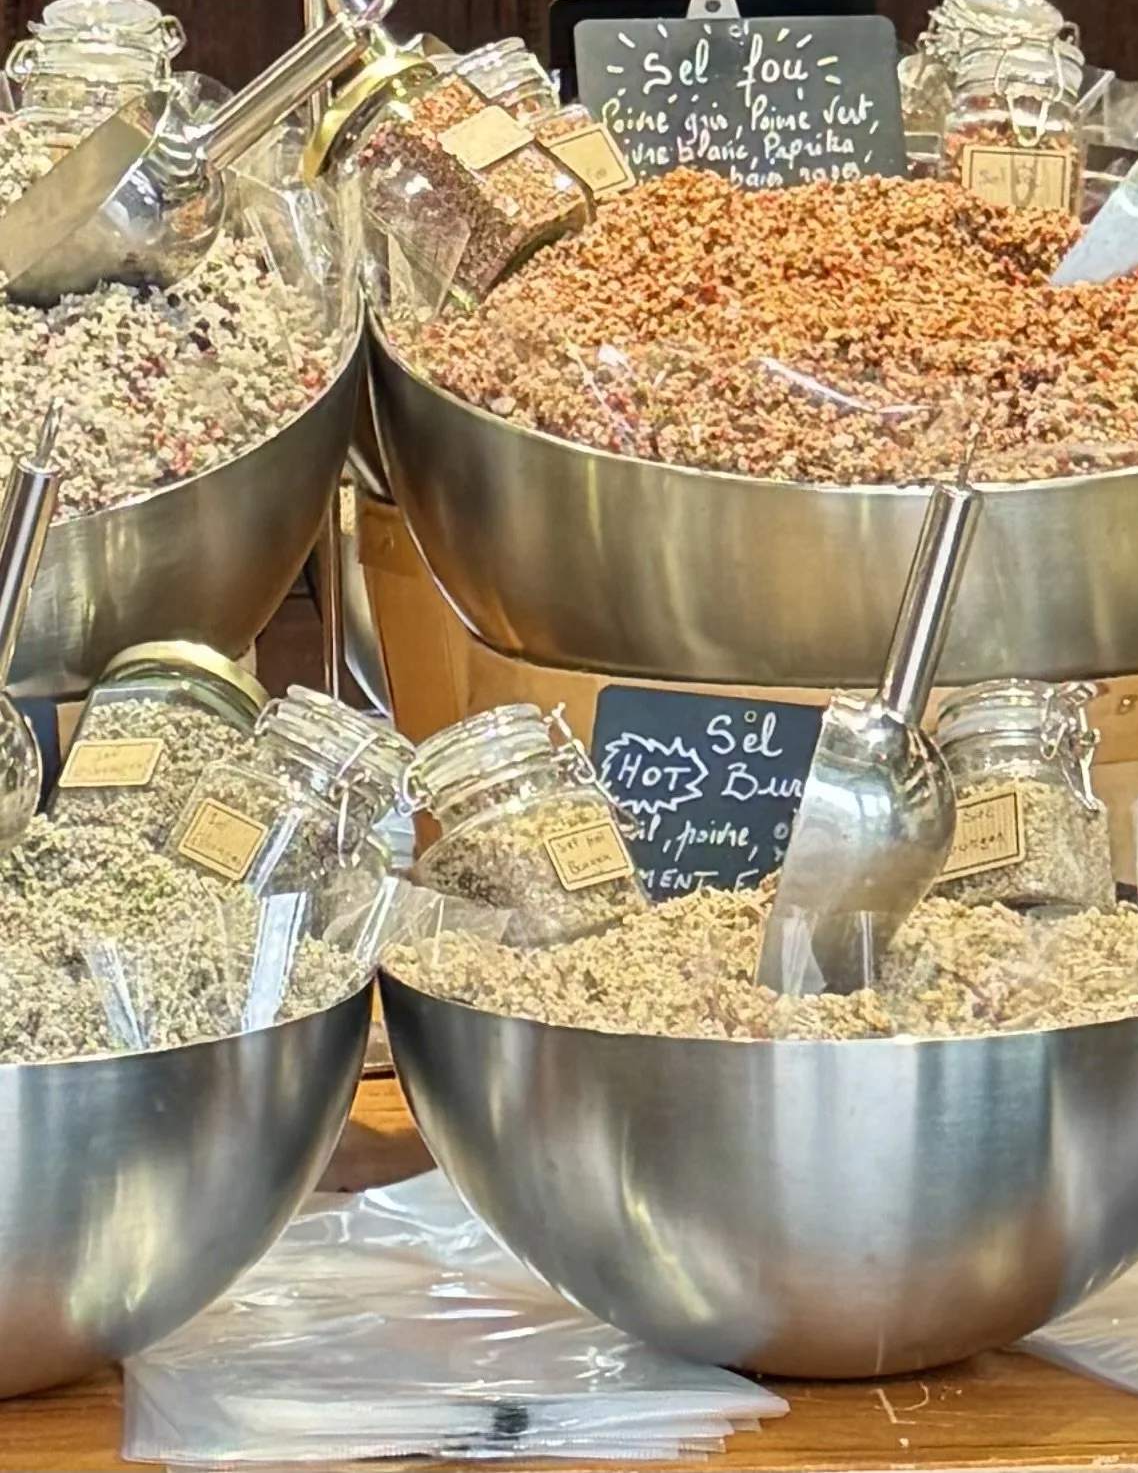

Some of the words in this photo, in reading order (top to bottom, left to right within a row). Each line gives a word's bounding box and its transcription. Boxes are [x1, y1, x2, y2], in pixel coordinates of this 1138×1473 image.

[643, 38, 710, 95] Sel
[736, 33, 809, 108] fou
[624, 138, 670, 166] ivre
[706, 711, 783, 758] Sel
[617, 753, 693, 792] HOT
[720, 762, 803, 802] Bur
[637, 813, 672, 854] il,
[637, 867, 719, 890] MENT
